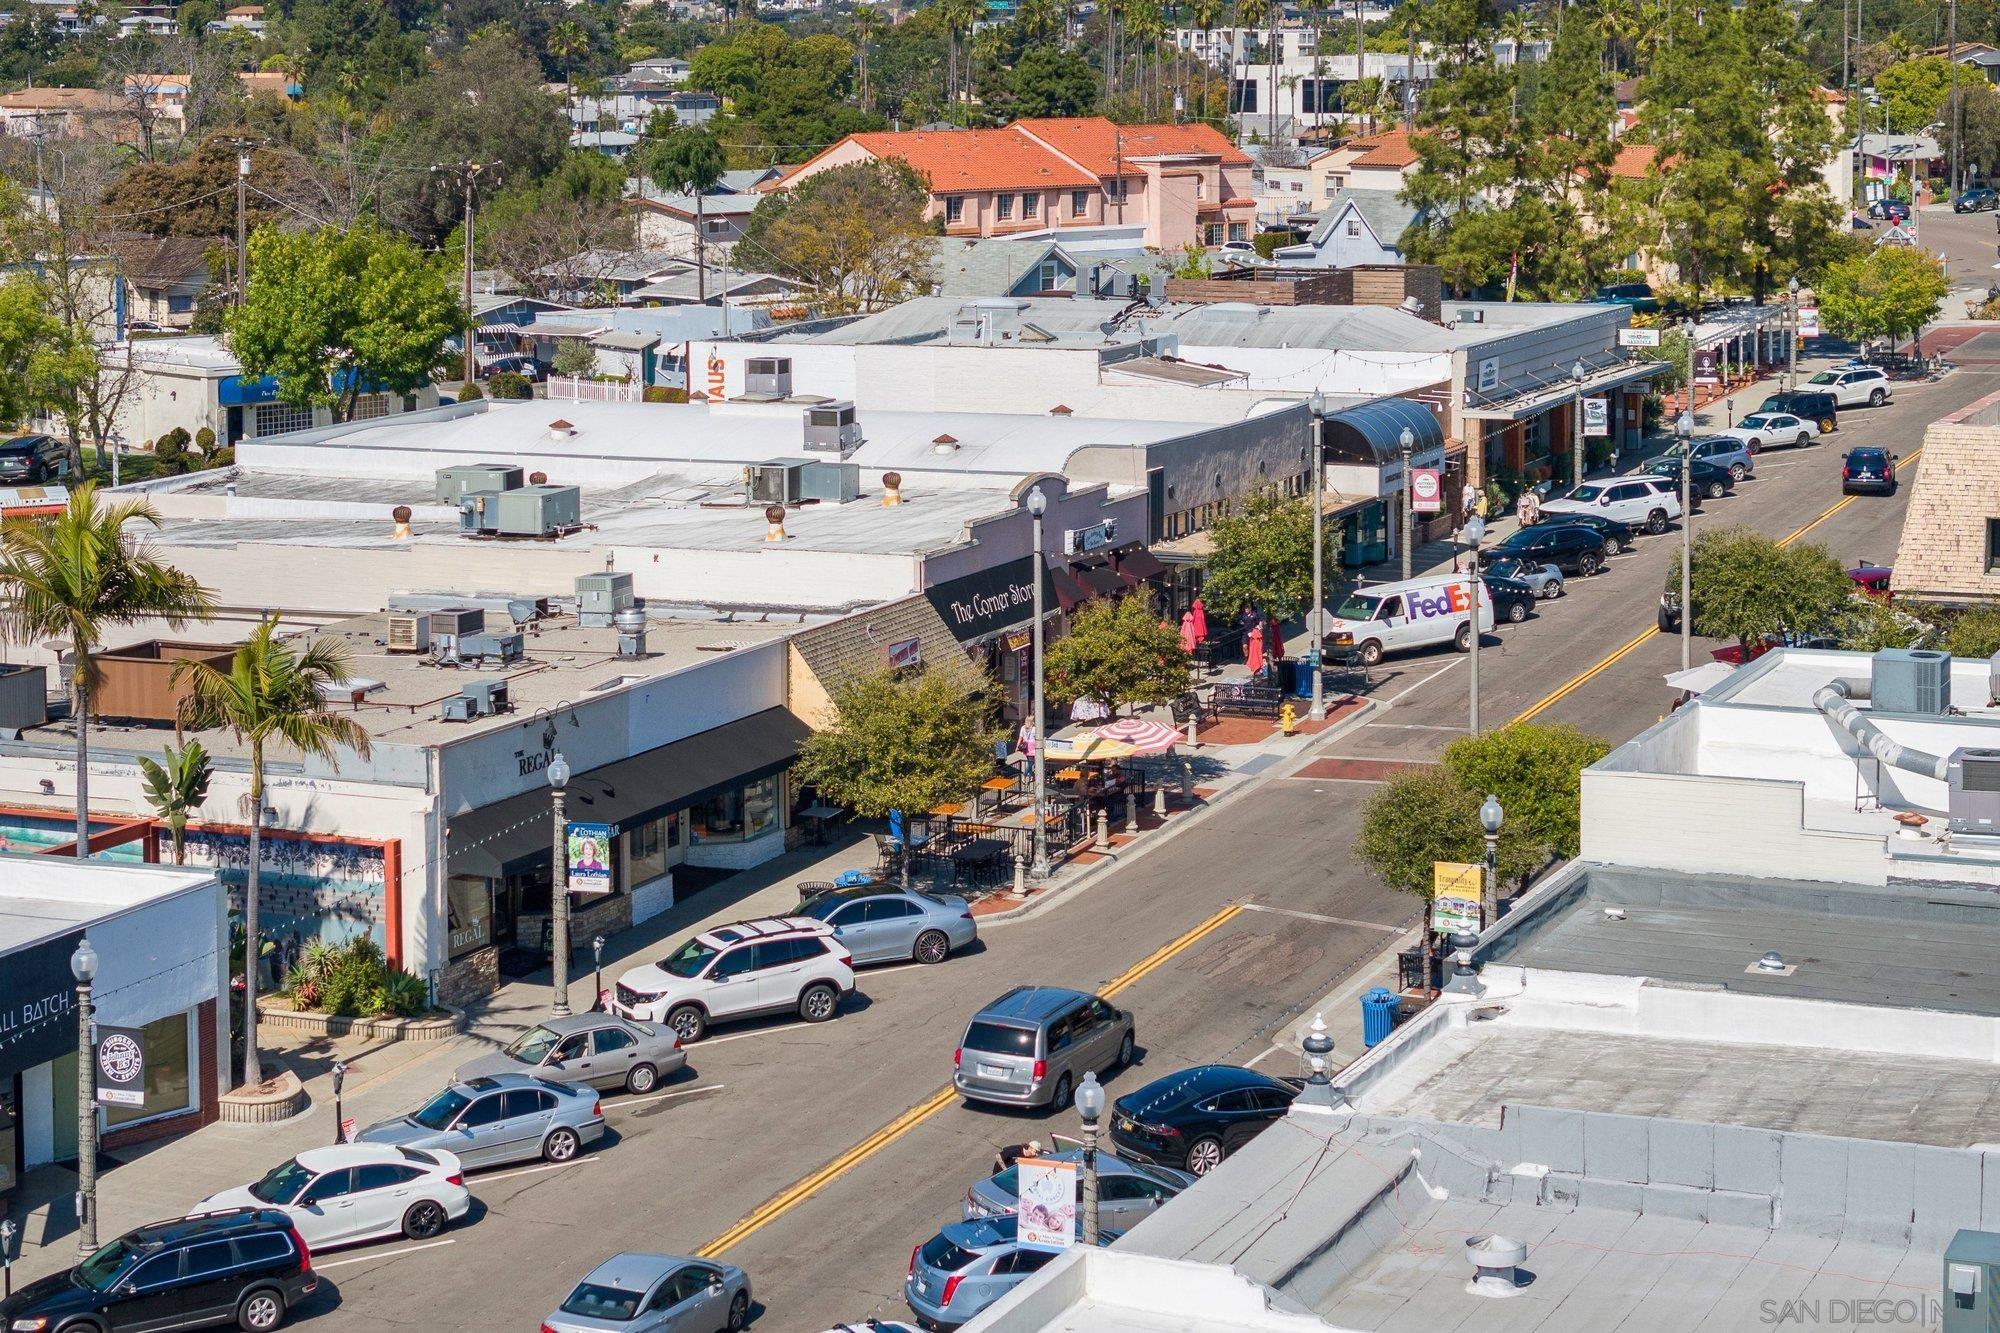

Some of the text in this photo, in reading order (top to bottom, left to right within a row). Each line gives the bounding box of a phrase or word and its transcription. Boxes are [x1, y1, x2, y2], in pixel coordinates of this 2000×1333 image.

[708, 359, 725, 404] AUS
[951, 600, 974, 624] The
[973, 593, 1009, 620] Corner
[1406, 583, 1483, 620] FedEx
[514, 750, 525, 758] THE
[580, 828, 607, 836] LOTHIAN
[587, 870, 608, 878] Lothian
[453, 925, 485, 948] REGAL
[0, 990, 69, 1033] LL BATCH
[105, 1036, 135, 1049] BURGERS
[102, 1055, 115, 1076] BREW
[121, 1058, 140, 1080] SPIRITS
